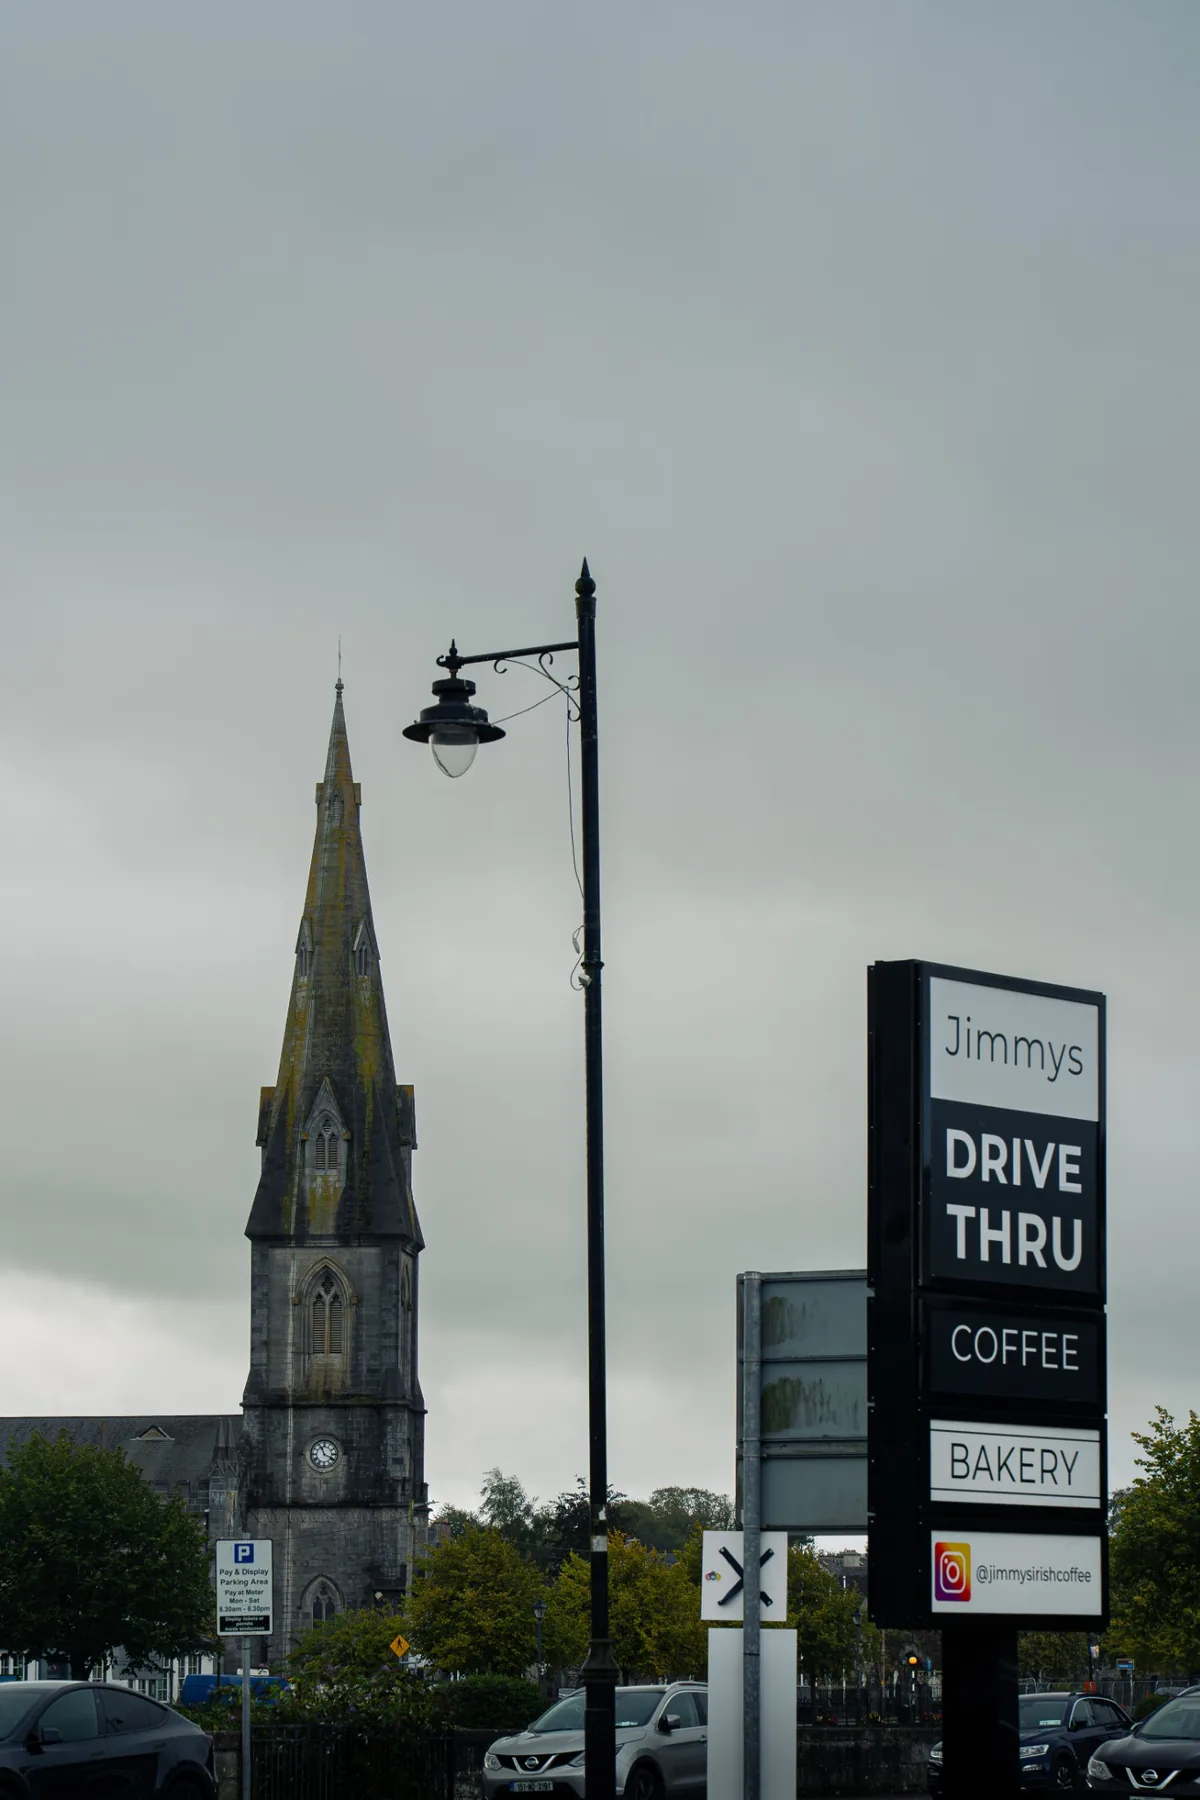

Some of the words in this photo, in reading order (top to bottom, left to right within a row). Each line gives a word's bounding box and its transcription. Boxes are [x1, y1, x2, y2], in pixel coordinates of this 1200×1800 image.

[945, 1014, 1084, 1082] Jimmys
[946, 1128, 1082, 1194] DRIVE
[946, 1203, 1082, 1272] THRU
[951, 1324, 1079, 1371] COFFEE
[950, 1442, 1080, 1487] BAKERY
[238, 1545, 251, 1562] P
[219, 1568, 233, 1577] Pay
[241, 1568, 269, 1577] Display
[220, 1578, 249, 1587] Parking
[976, 1564, 1092, 1585] @jimmysirishcoffee
[224, 1589, 237, 1597] Pay
